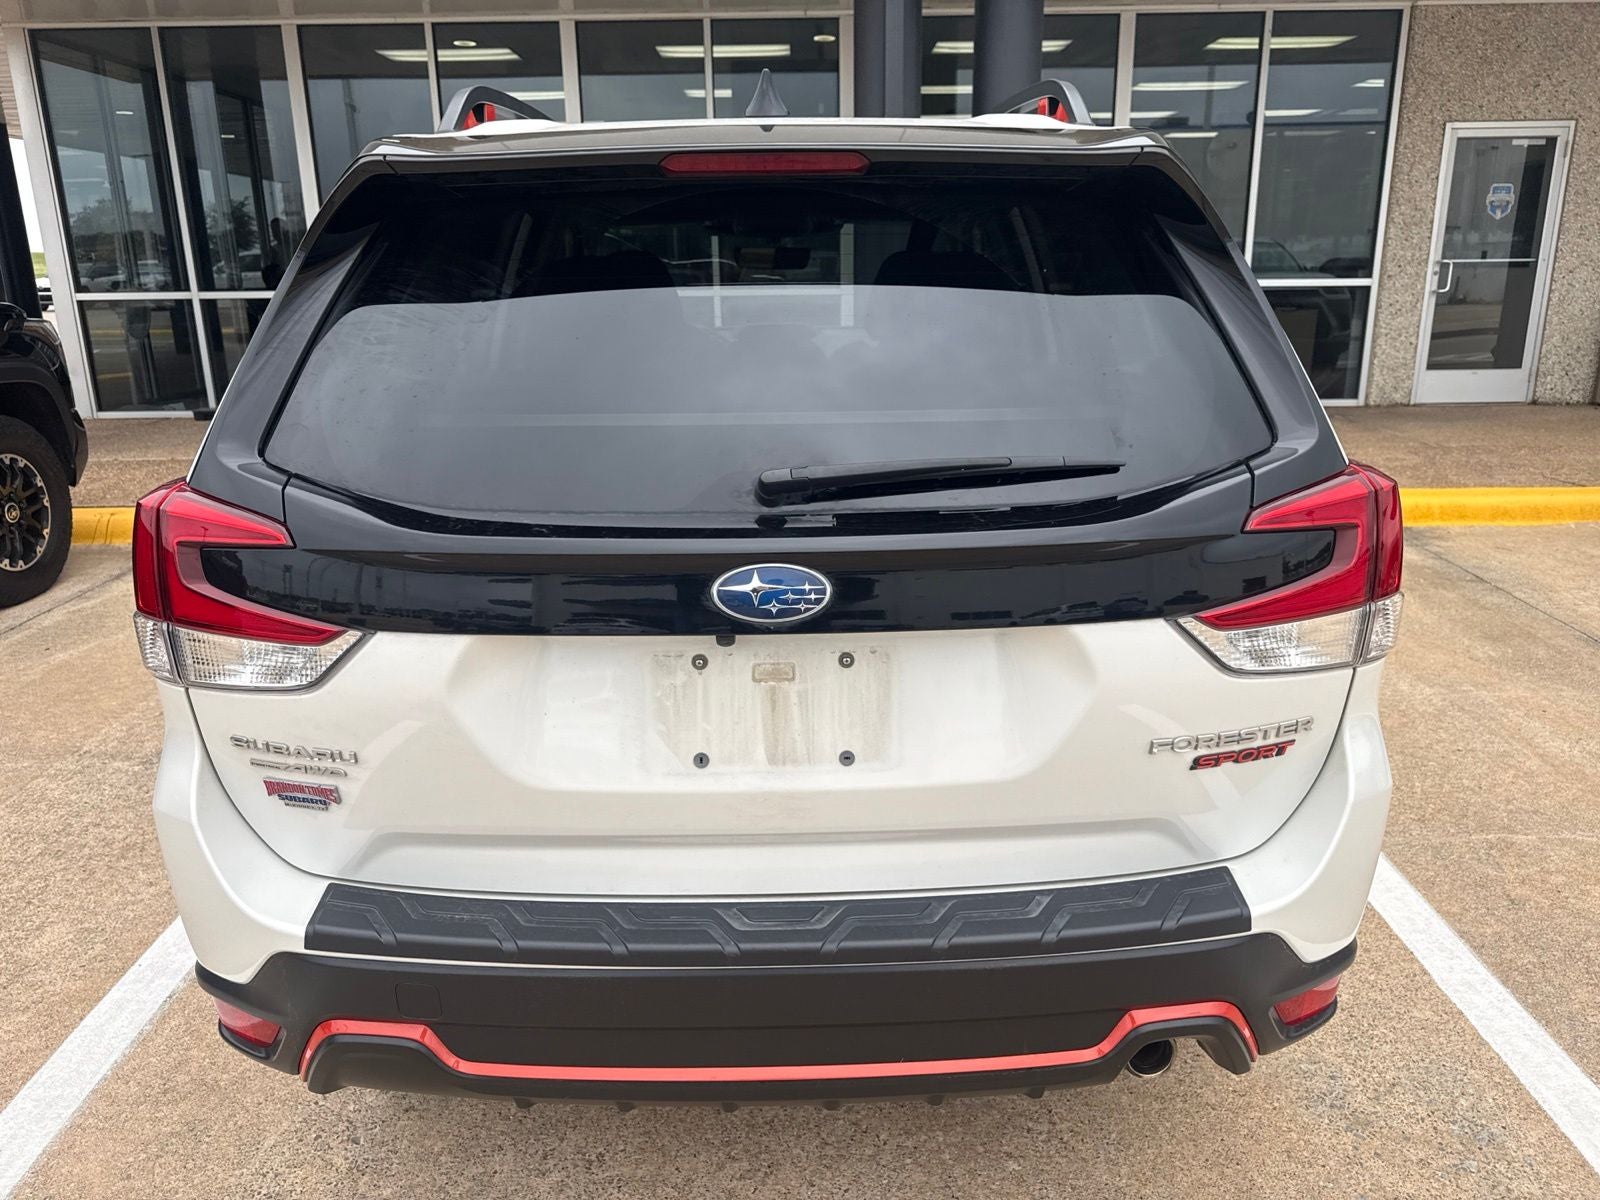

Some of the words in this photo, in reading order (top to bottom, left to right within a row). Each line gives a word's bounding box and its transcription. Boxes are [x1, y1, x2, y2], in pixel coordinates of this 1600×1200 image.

[230, 734, 358, 764] SUBARU
[1148, 715, 1313, 754] FORESTER
[1190, 739, 1296, 770] SPORT
[277, 794, 327, 806] SUBARU
